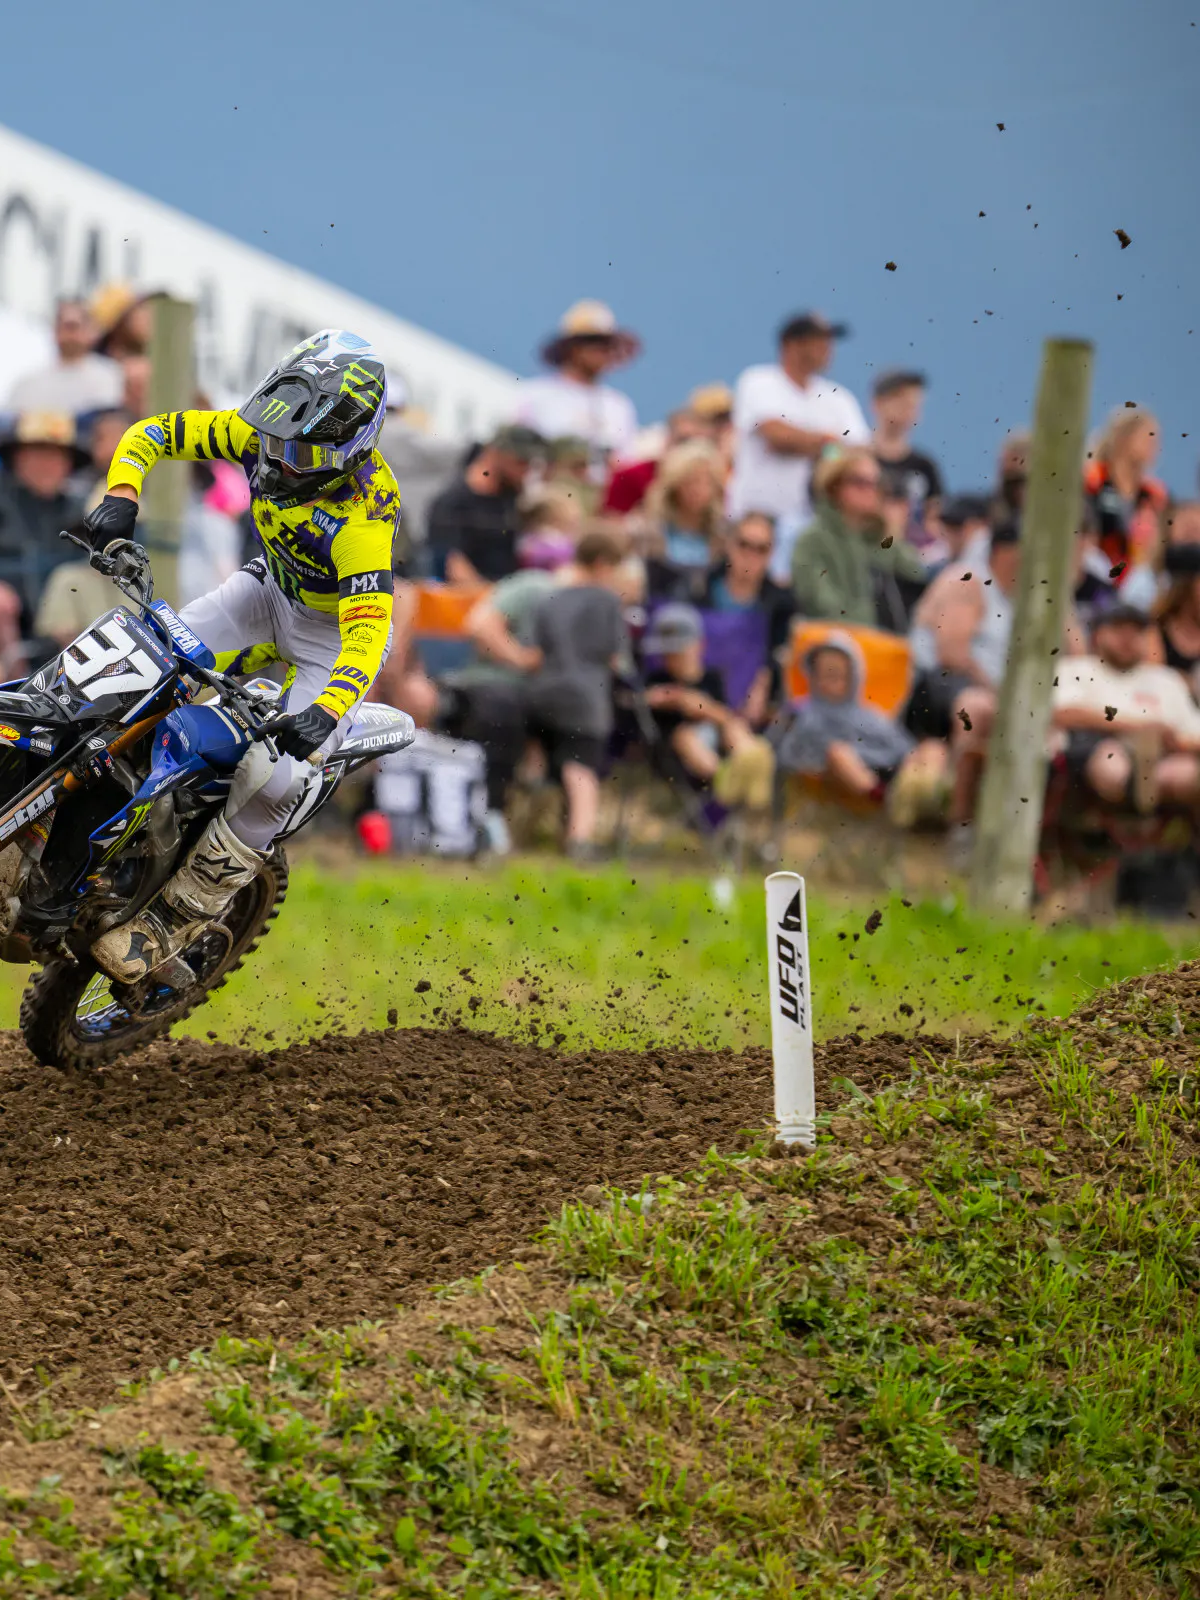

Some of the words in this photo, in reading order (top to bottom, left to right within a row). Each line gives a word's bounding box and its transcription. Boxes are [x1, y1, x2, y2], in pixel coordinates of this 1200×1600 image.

[350, 572, 380, 594] MX
[62, 618, 163, 702] 37
[362, 731, 404, 750] DUNLOP
[776, 933, 800, 1025] UFO
